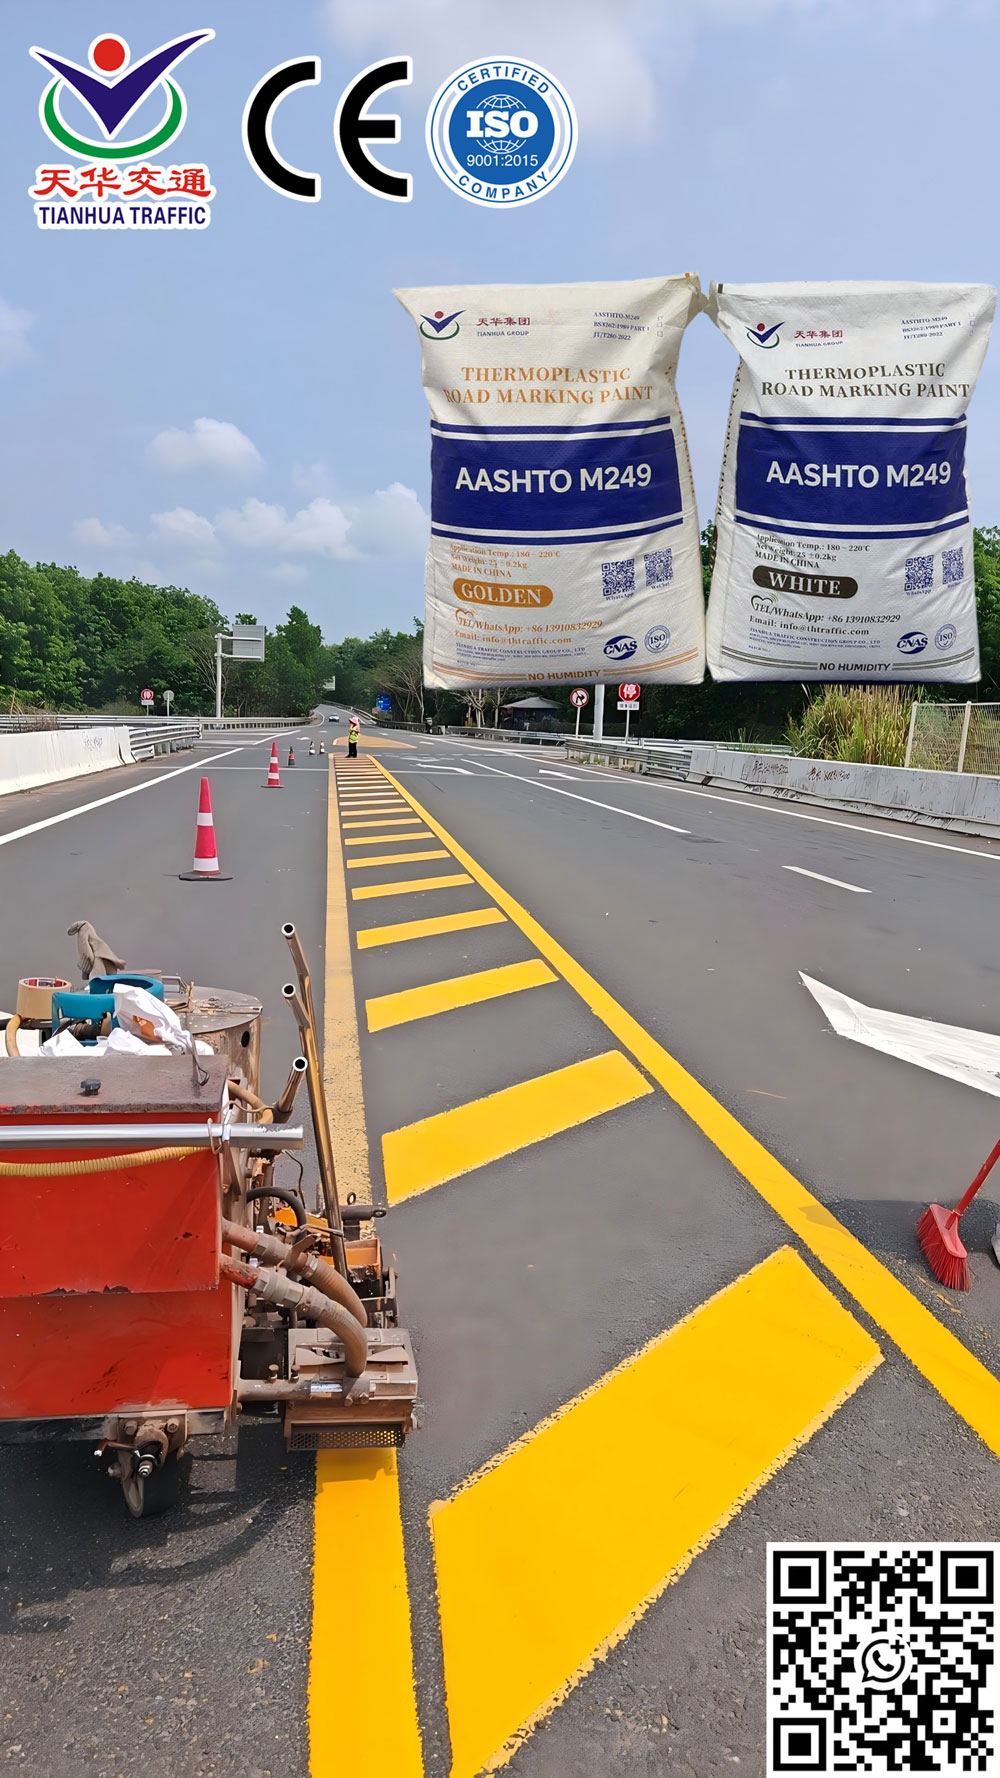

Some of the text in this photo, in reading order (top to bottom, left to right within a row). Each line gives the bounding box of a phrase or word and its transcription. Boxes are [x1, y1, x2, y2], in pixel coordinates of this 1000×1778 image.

[476, 316, 530, 326] 天华集团
[794, 330, 842, 339] 天华集团
[461, 366, 631, 384] THERMOPLASTIC
[785, 362, 946, 380] THERMOPLASTIC
[496, 388, 593, 405] MARKING
[600, 385, 653, 402] PAINT
[761, 382, 970, 398] ROAD MARKING PAINT
[455, 463, 652, 493] AASHTO M249
[766, 461, 951, 488] AASHTO M249
[797, 541, 825, 550] Temp.:
[755, 550, 820, 569] MADE IN CHINA
[451, 563, 512, 578] MADE IN CHINA
[768, 571, 841, 595] WHITE
[461, 582, 542, 604] GOLDEN
[755, 602, 901, 624] TEL/WhatsApp: +86 13910832929
[526, 624, 542, 632] +86
[750, 616, 870, 635] Email: info@thtraffic.com
[650, 633, 665, 644] ISO
[897, 637, 928, 648] CNAS
[940, 632, 953, 641] ISO
[603, 640, 638, 655] CNAS
[819, 662, 890, 672] NO HUMIDITY
[528, 669, 601, 681] NO HUMIDITY
